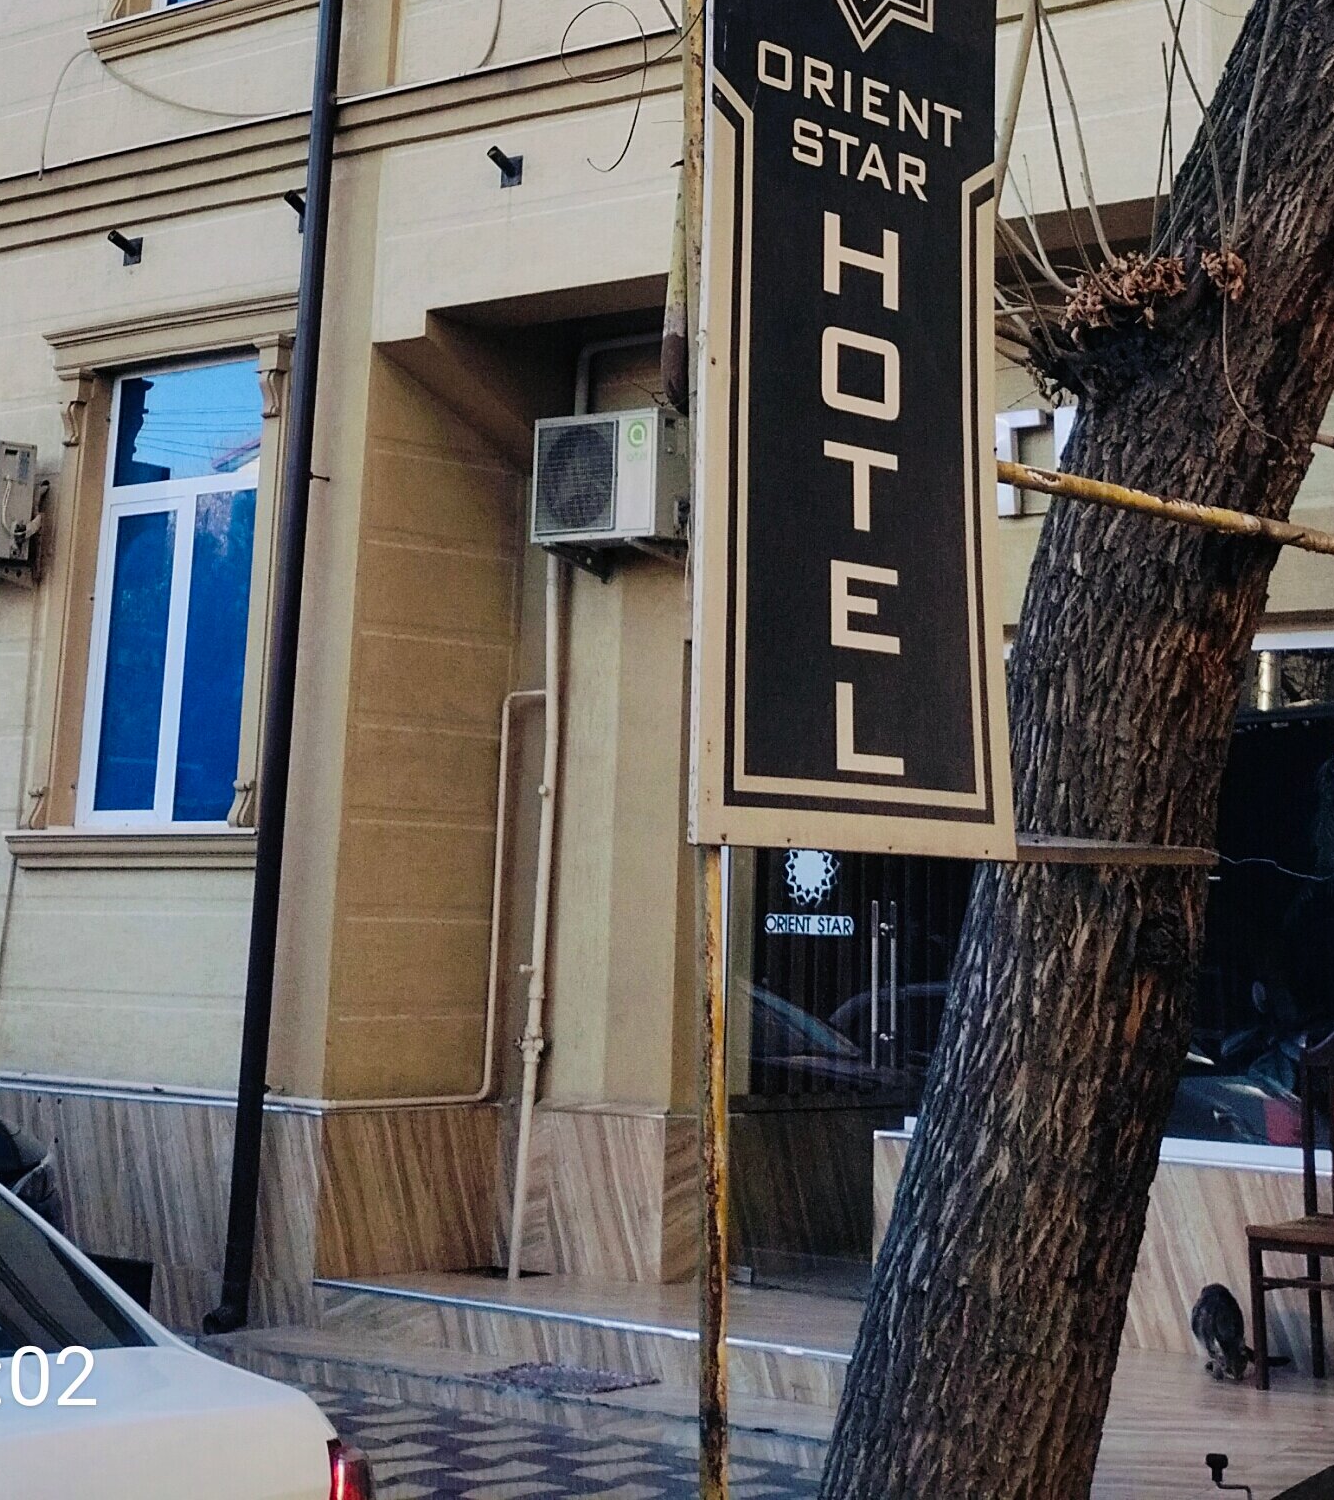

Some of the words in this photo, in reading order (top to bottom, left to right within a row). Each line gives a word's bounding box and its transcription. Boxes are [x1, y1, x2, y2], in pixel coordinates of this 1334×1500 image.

[757, 40, 963, 149] ORIENT
[792, 119, 928, 202] STAR
[821, 211, 905, 777] HOTEL
[765, 913, 812, 933] ORIENT
[817, 915, 854, 935] STAR
